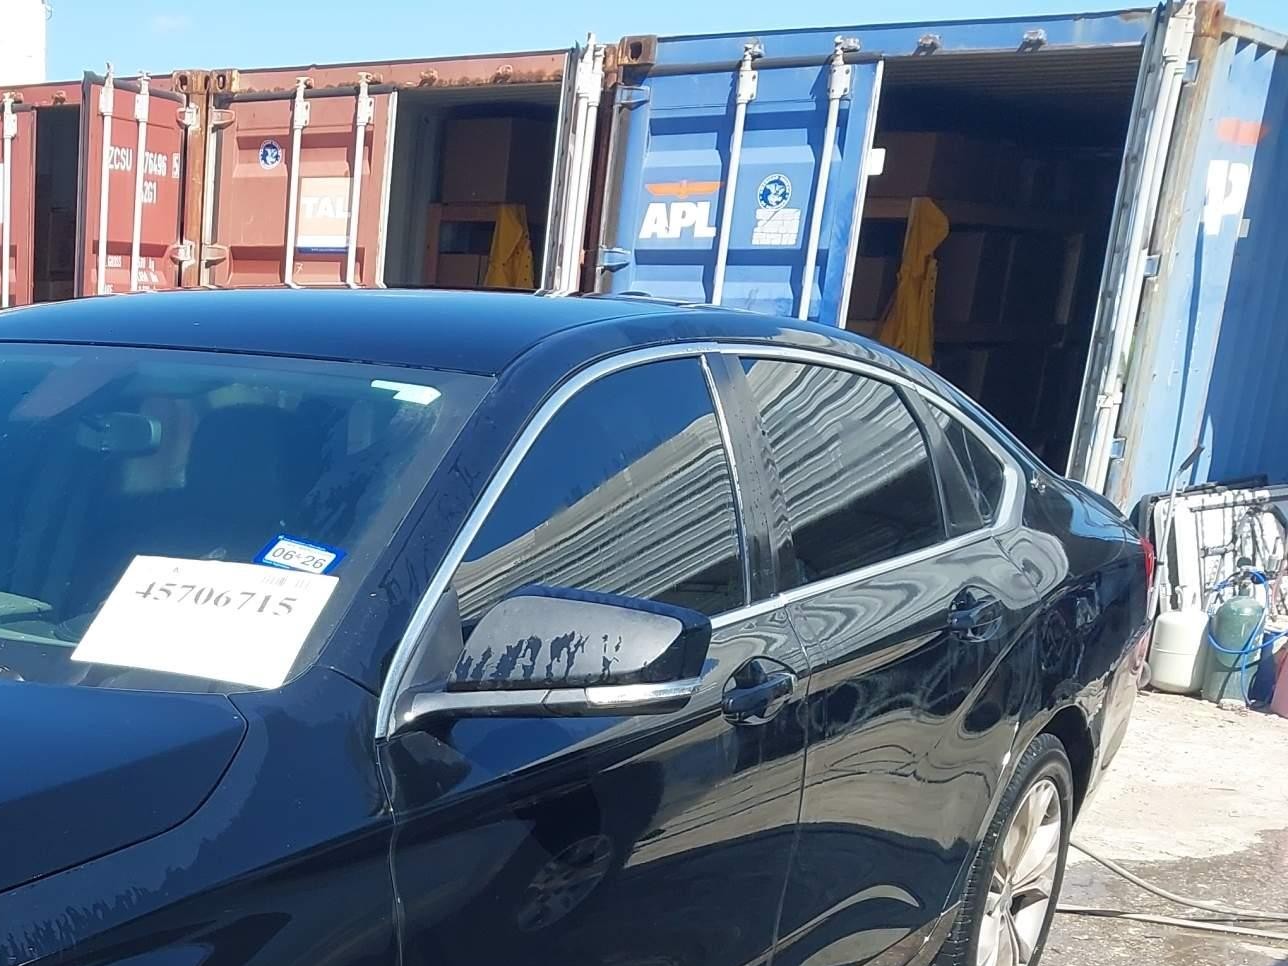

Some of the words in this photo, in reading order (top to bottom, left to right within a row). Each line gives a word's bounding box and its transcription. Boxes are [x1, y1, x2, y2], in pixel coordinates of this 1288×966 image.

[109, 146, 133, 171] ZCSU
[140, 180, 157, 204] 2G1
[302, 195, 350, 219] TAL
[639, 201, 717, 239] APL
[135, 581, 298, 617] 45706715
